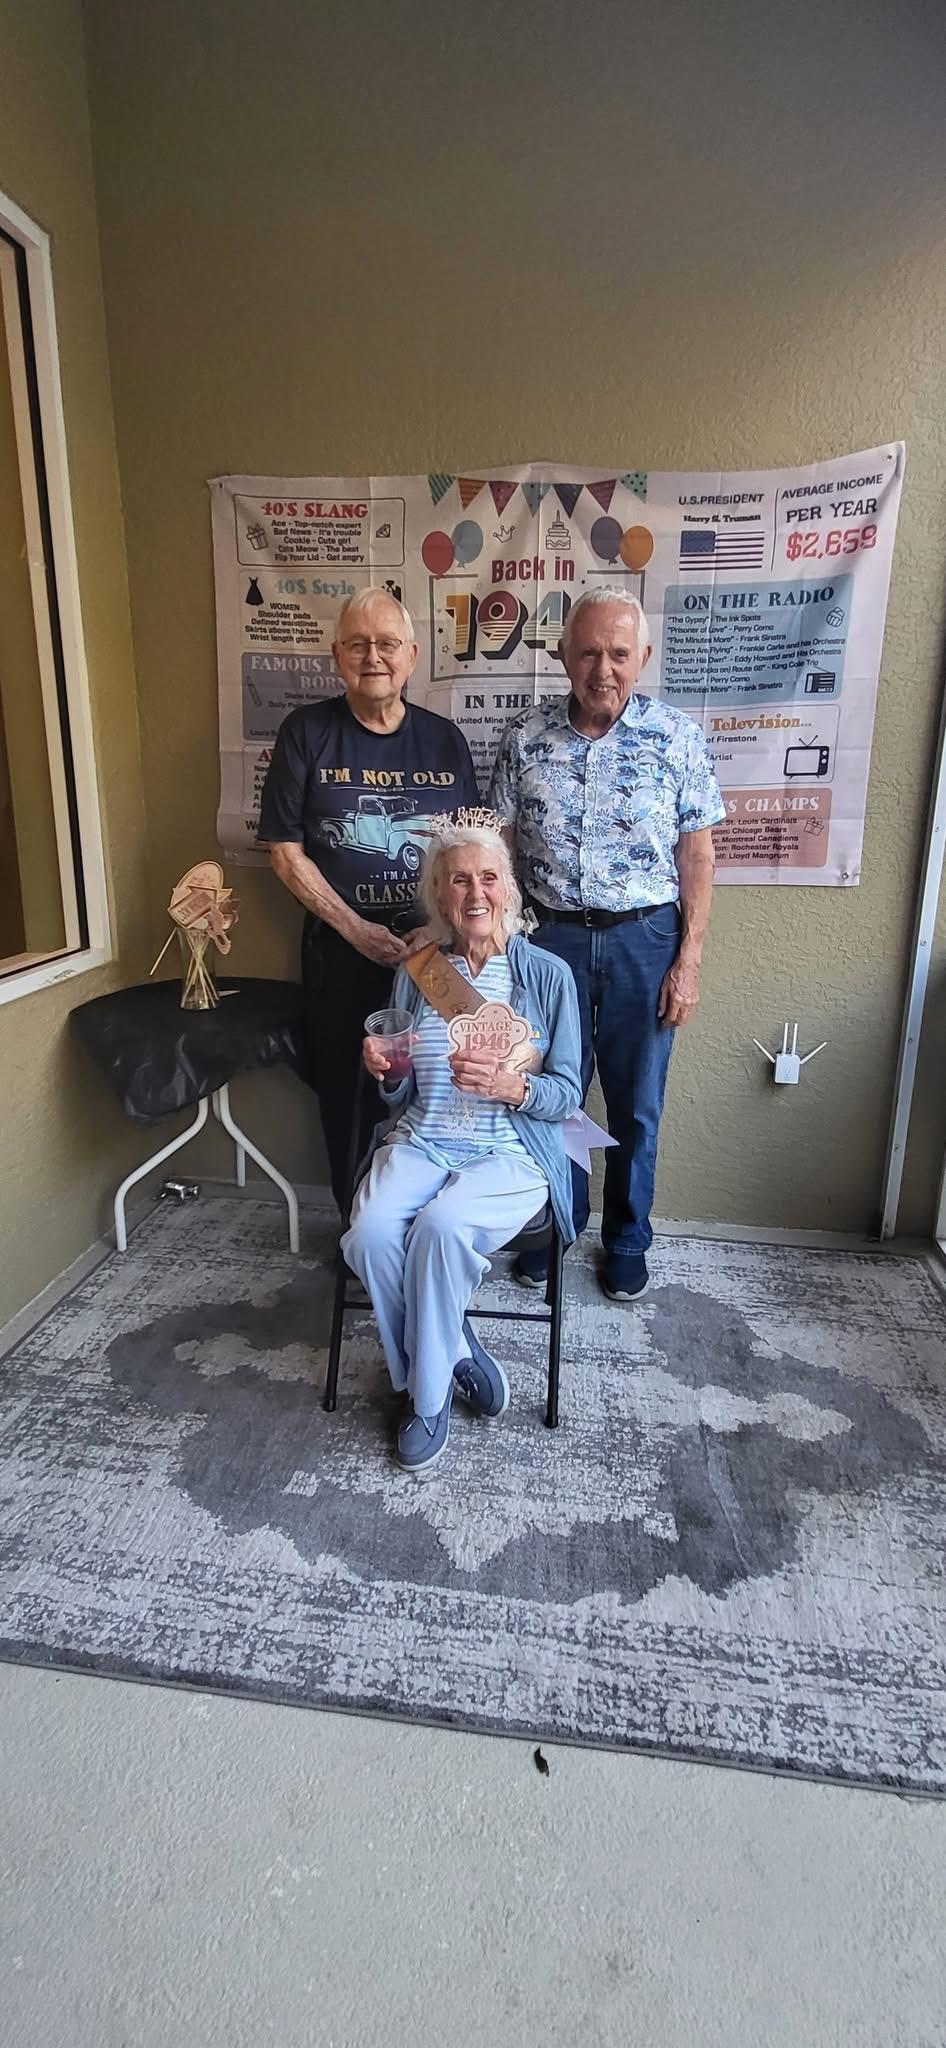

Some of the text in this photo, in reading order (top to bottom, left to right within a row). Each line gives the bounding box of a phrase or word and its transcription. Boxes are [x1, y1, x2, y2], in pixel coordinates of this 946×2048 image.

[781, 473, 884, 500] AVERAGE INCOME
[261, 502, 368, 518] 40'S SLANG
[786, 498, 878, 524] PER YEAR
[683, 515, 709, 524] Harry
[724, 514, 761, 523] Truman
[283, 536, 310, 544] Cookie
[338, 537, 351, 545] girl
[786, 524, 878, 562] $2,659
[492, 556, 575, 584] Back in
[312, 578, 355, 598] Style
[683, 586, 834, 610] ON THE RADIO
[258, 610, 290, 618] Shoulder
[251, 618, 280, 626] Defined
[443, 590, 574, 662] 194
[245, 625, 267, 633] Skirts
[734, 625, 752, 633] Perry
[271, 635, 294, 643] length
[251, 655, 322, 672] FAMOUS
[735, 655, 752, 663] Eddy
[758, 682, 783, 690] Sinatra
[464, 695, 485, 708] IN
[493, 694, 531, 708] THE
[470, 740, 486, 748] first
[717, 735, 757, 743] Firestone
[320, 768, 455, 786] I'M NOT OLD
[745, 796, 819, 812] CHAMPS
[773, 843, 798, 851] Royals
[729, 852, 750, 860] Lloyd
[752, 852, 789, 860] Mangrum
[383, 870, 408, 880] I'M A
[355, 883, 417, 903] CLASS
[460, 1022, 512, 1032] VINTAGE
[463, 1033, 510, 1050] 1946
